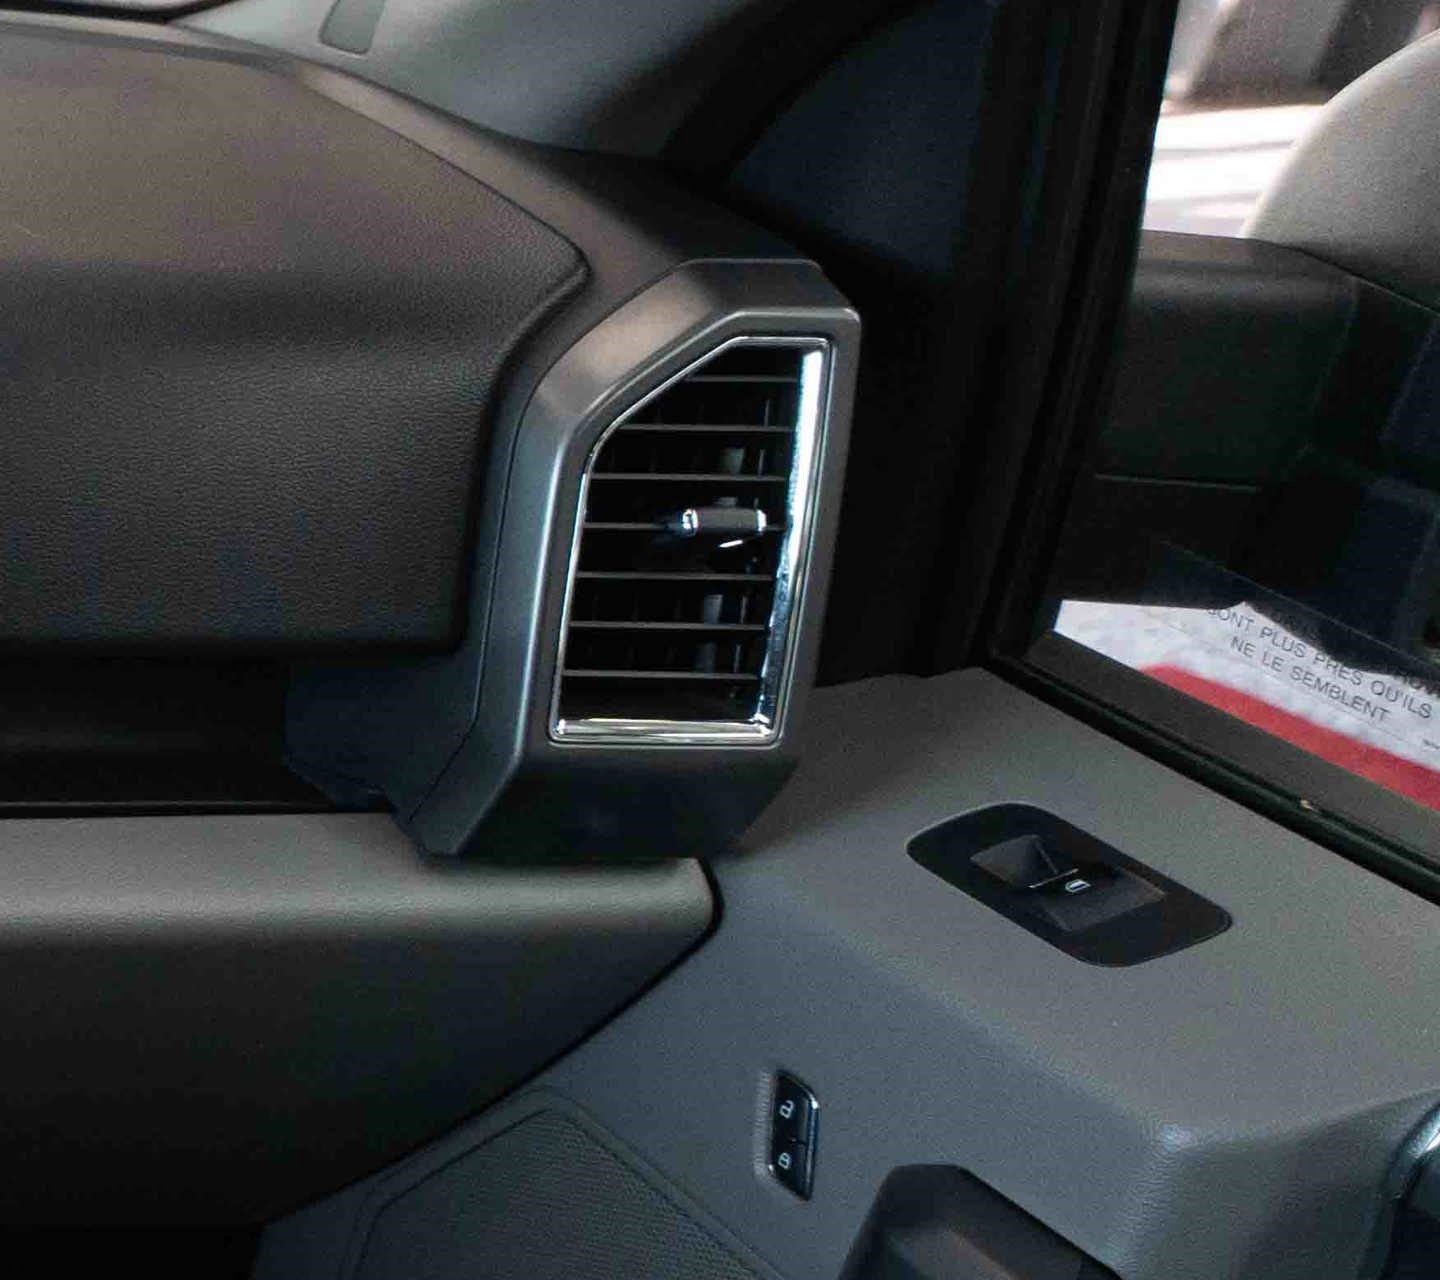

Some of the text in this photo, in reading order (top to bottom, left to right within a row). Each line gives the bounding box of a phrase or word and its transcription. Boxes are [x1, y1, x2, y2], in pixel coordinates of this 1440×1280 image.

[1259, 625, 1308, 658] PLUS
[1230, 636, 1256, 658] NE
[1261, 649, 1283, 673] LE
[1290, 666, 1392, 723] SEMBLENT
